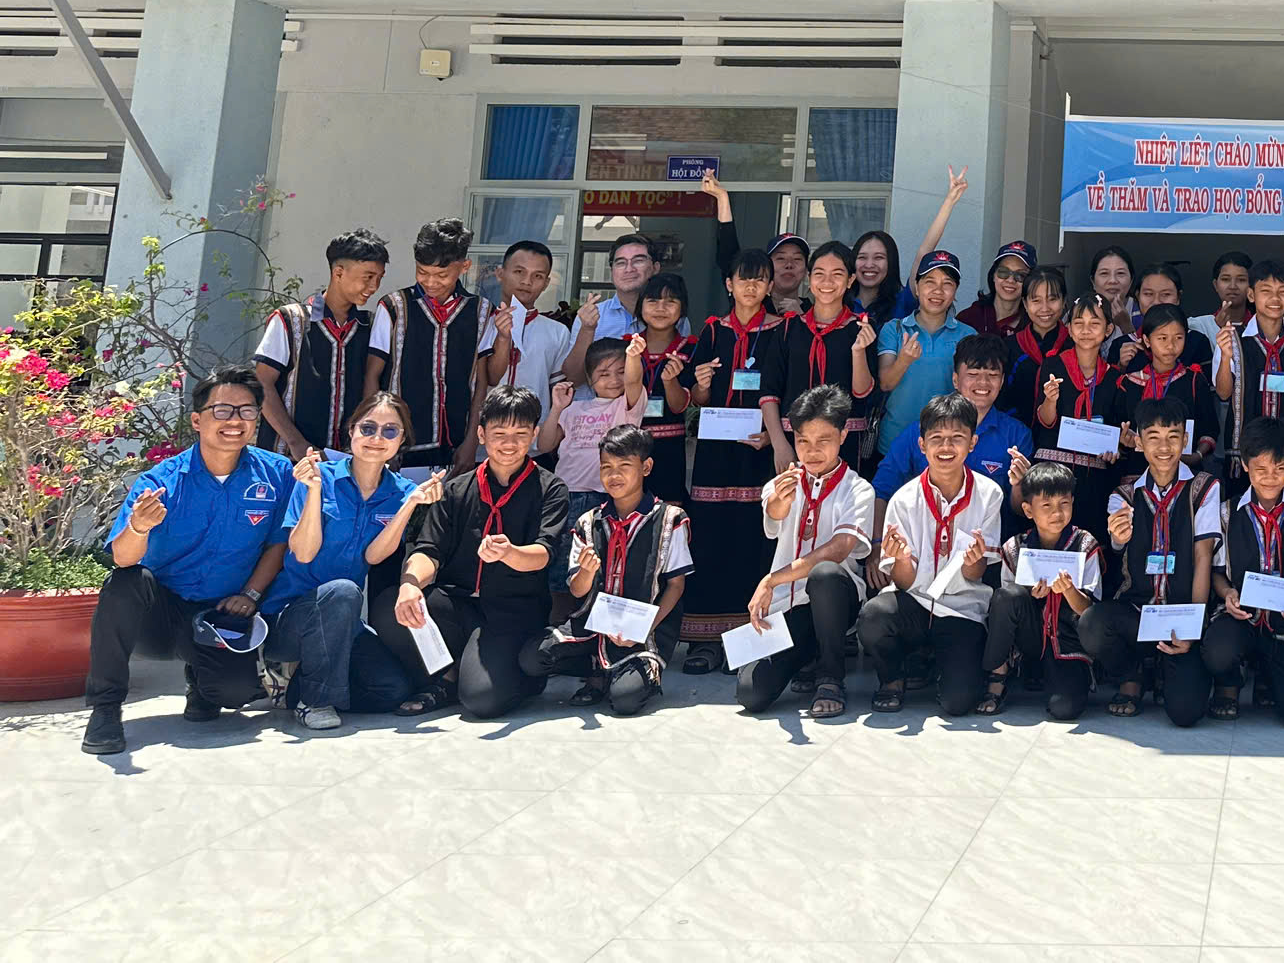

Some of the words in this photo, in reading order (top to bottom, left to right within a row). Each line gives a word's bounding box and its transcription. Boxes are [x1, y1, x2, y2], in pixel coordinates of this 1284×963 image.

[1134, 133, 1177, 171] NHIỆT
[1180, 134, 1212, 171] LIỆT
[1215, 135, 1251, 167] CHÀO
[671, 167, 688, 178] HỘI
[1087, 172, 1106, 211] VỀ
[1110, 179, 1149, 212] THĂM
[1152, 180, 1170, 212] VÀ
[1174, 188, 1210, 213] TRAO
[1214, 188, 1242, 220] HỌC
[1245, 174, 1282, 215] BỔNG
